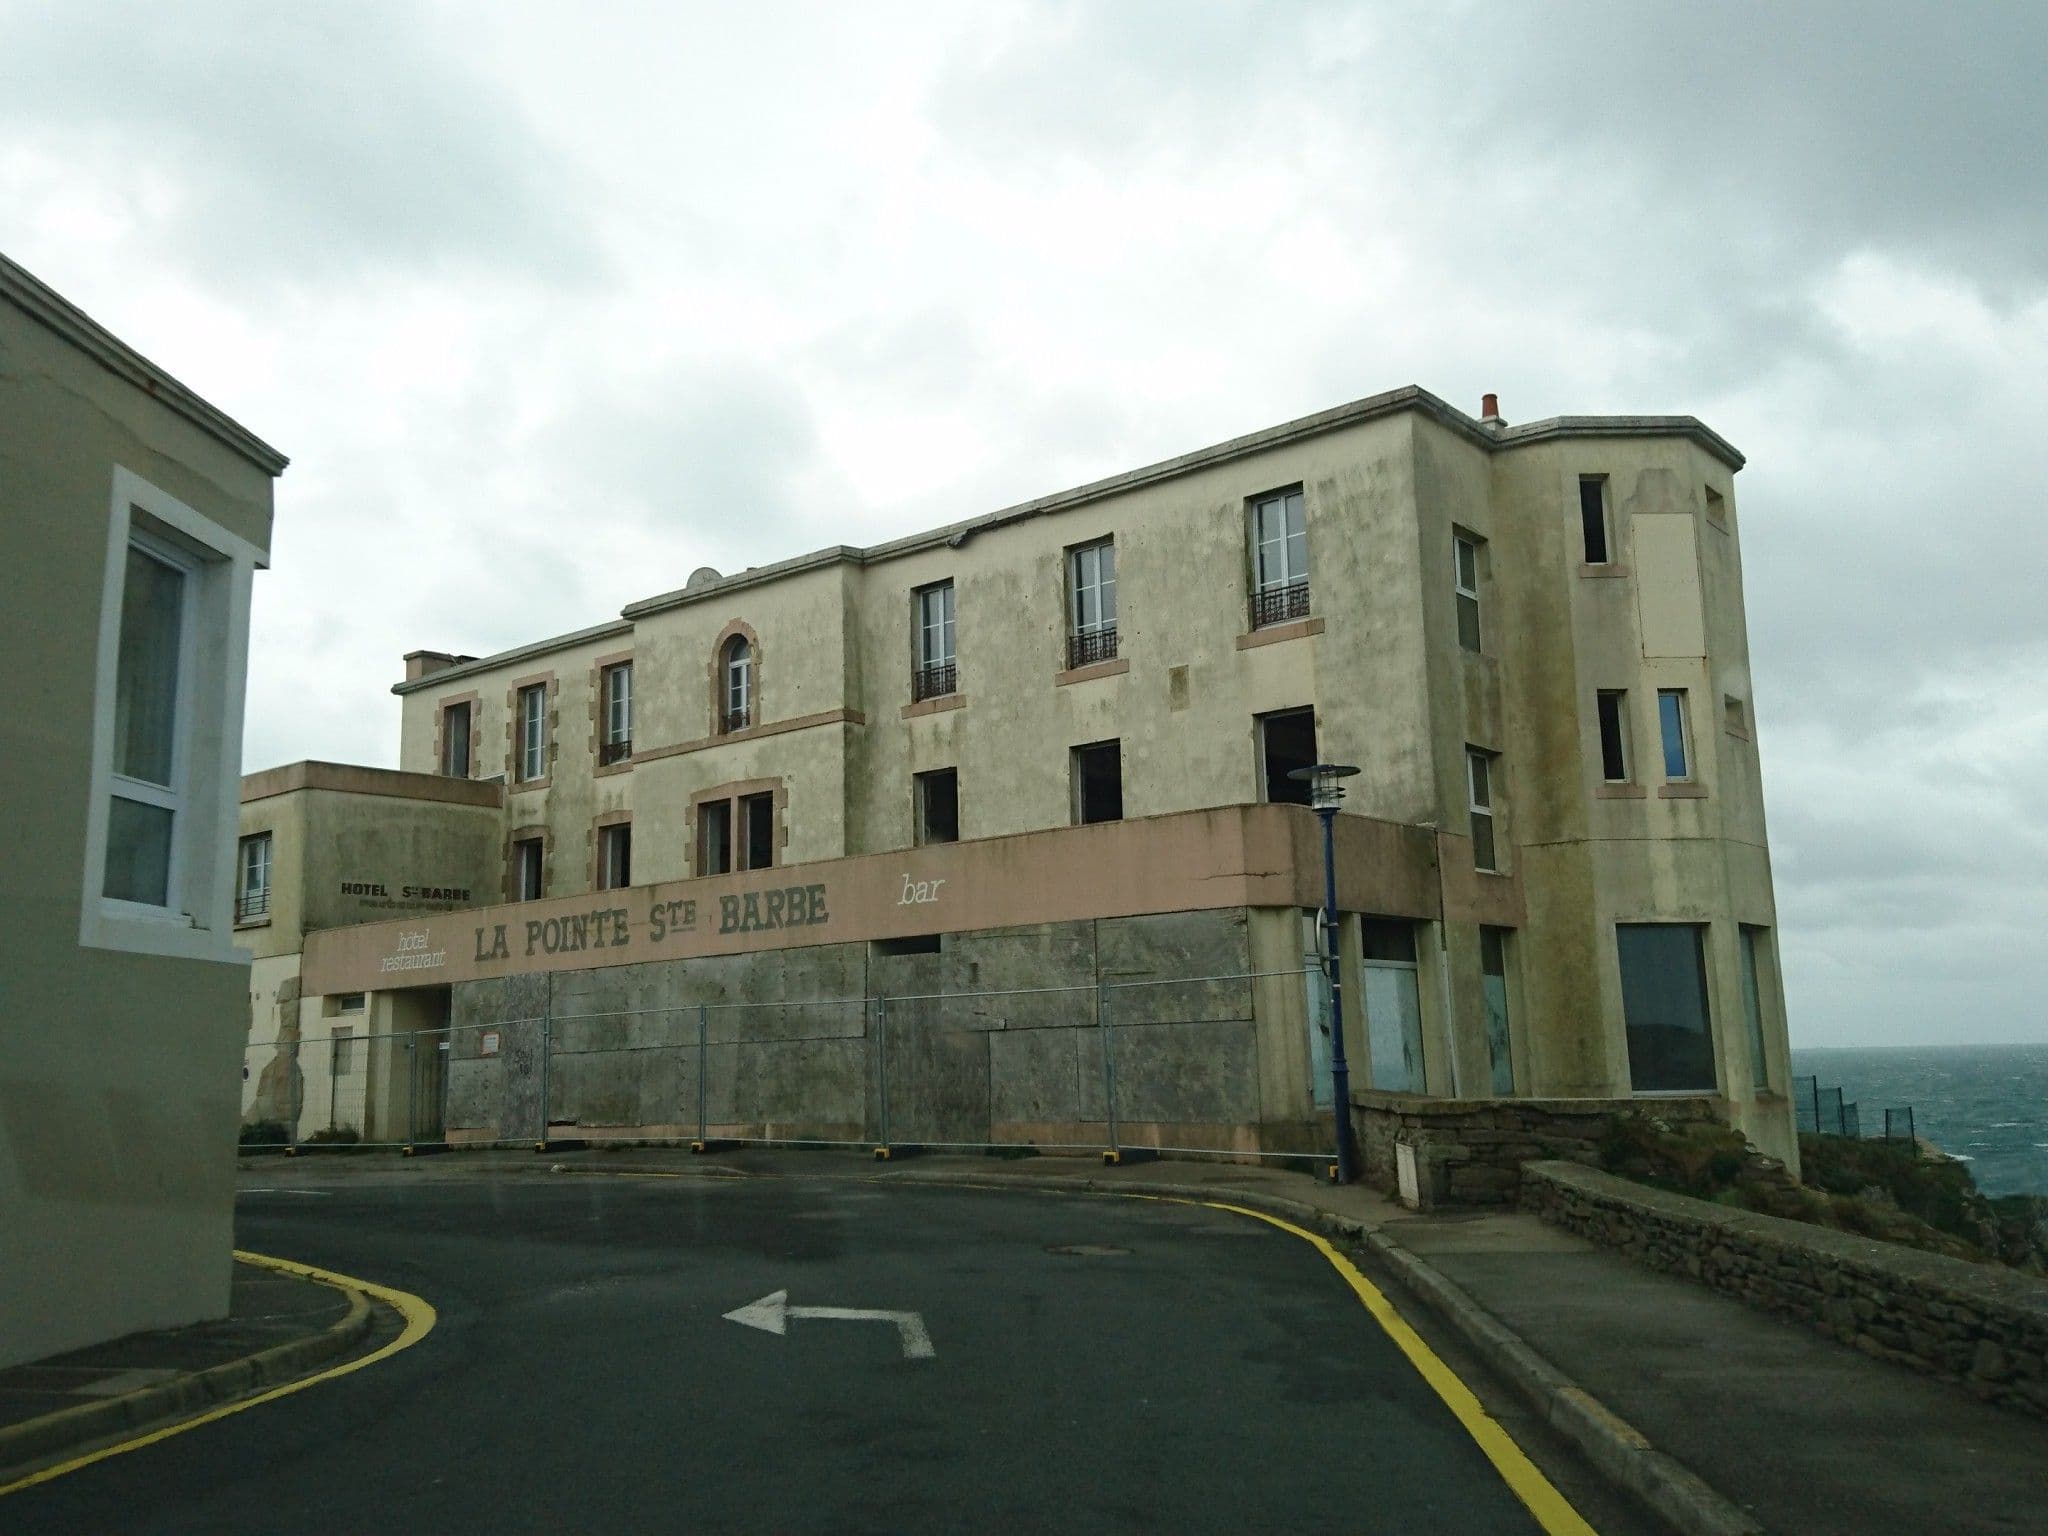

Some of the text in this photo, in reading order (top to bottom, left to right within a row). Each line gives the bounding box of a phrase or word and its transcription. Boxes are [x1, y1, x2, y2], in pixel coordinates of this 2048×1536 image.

[341, 883, 388, 897] HOTEL
[897, 873, 946, 905] bar
[475, 924, 510, 961] LA
[526, 908, 630, 955] POINTE
[719, 884, 829, 934] BARBE
[381, 948, 446, 972] restaurant
